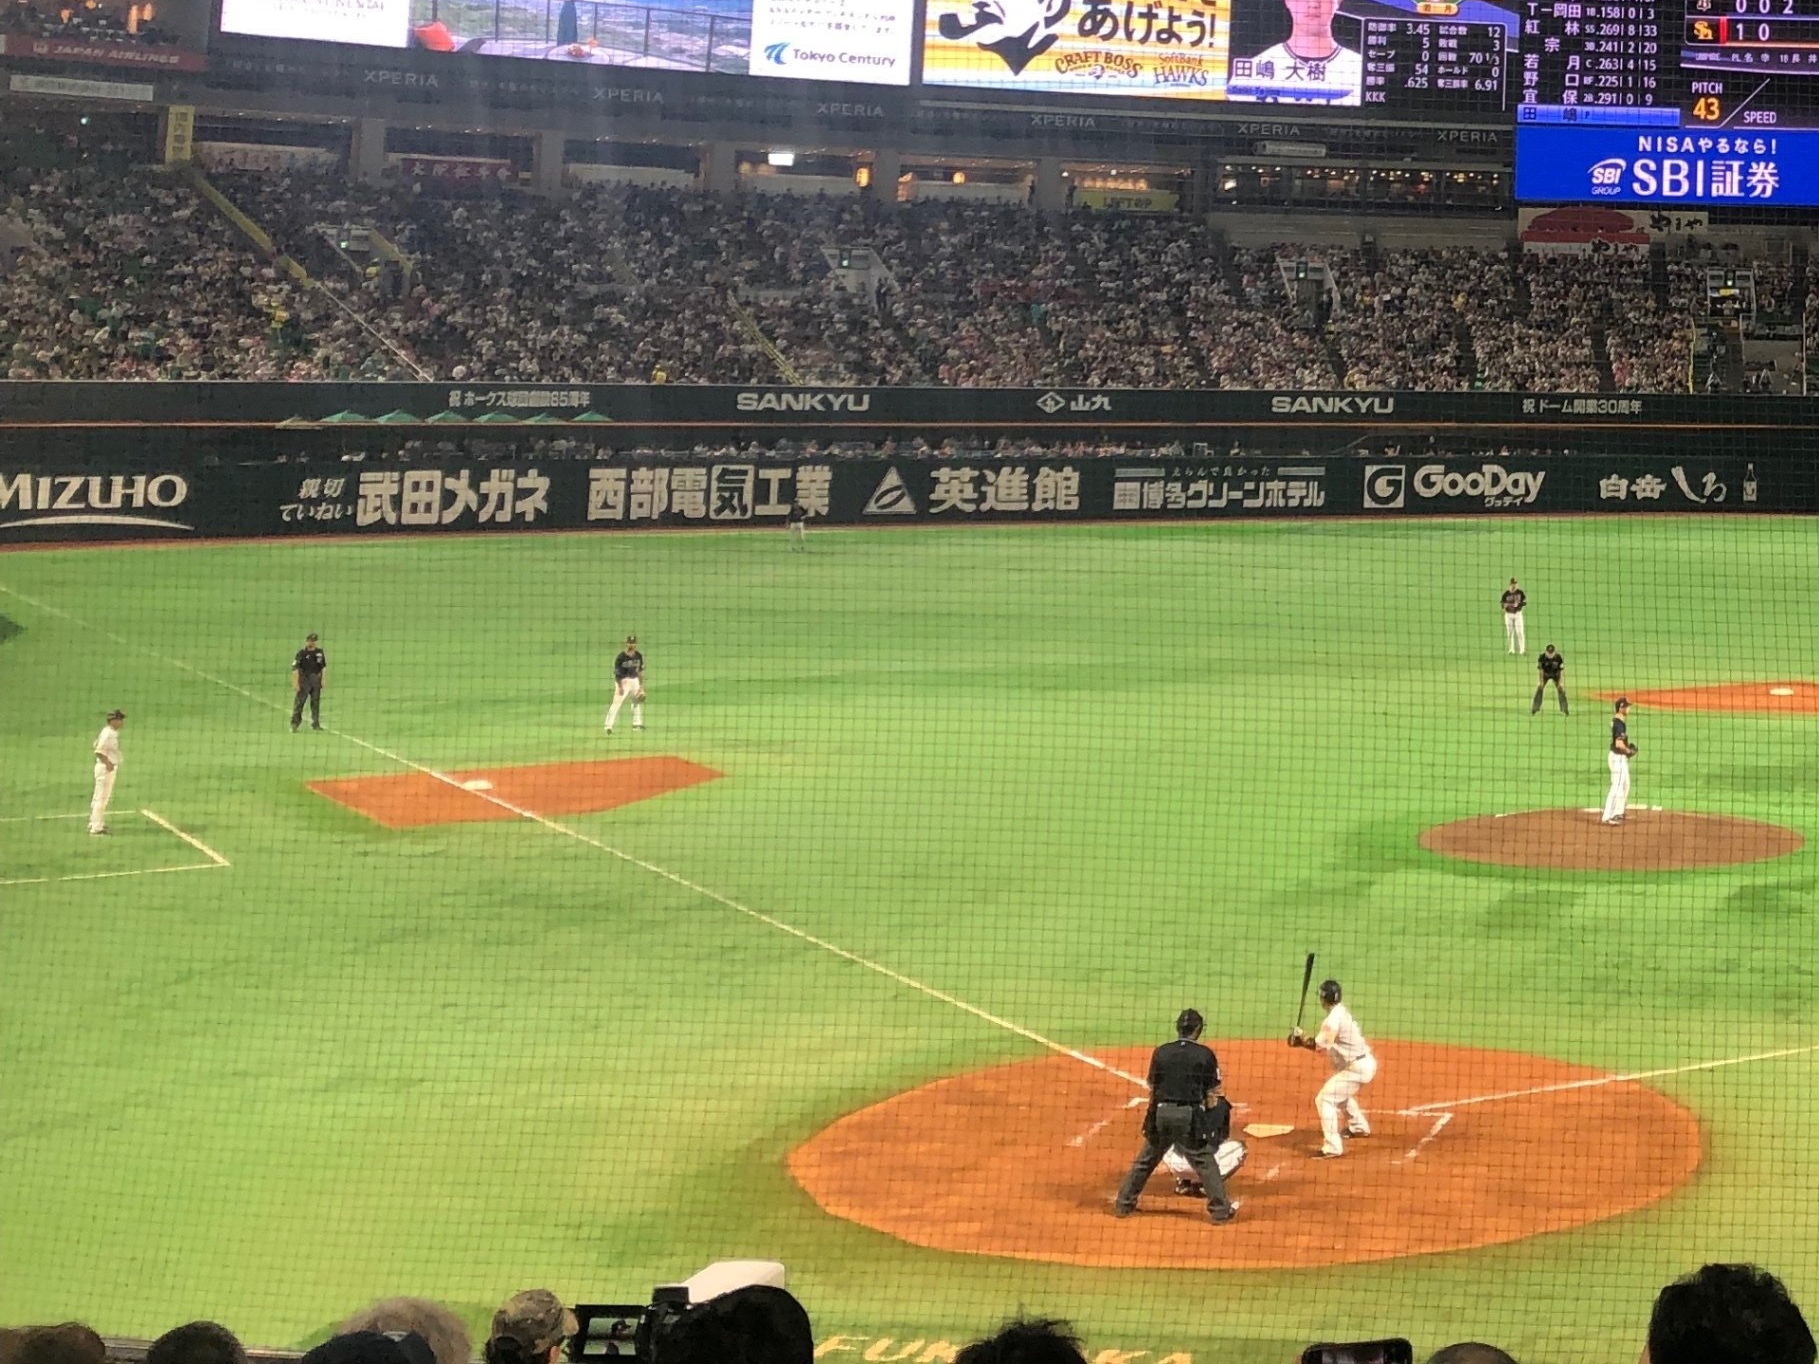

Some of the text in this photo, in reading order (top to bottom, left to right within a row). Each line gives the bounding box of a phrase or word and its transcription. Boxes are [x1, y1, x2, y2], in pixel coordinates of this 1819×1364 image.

[1596, 7, 1620, 19] .158
[1406, 23, 1500, 38] 3.45 12
[1596, 24, 1620, 36] .269
[1758, 23, 1770, 41] 0
[54, 45, 104, 58] JAPAN
[1545, 38, 1618, 53] 宗 .241
[793, 48, 896, 67] Tokyo Century
[1368, 50, 1396, 59] セーブ
[1055, 51, 1144, 78] CRAFT BOSS
[1235, 60, 1326, 81] 田嶋 大樹
[1415, 64, 1428, 75] 54
[1595, 59, 1619, 70] .263
[1153, 65, 1209, 86] HAWKS
[1595, 76, 1619, 87] .225
[1474, 80, 1498, 91] 6.91
[1691, 82, 1723, 94] PITCH
[1366, 91, 1386, 102] KKK
[1595, 93, 1617, 105] .291
[818, 101, 885, 117] XPERIA
[1692, 97, 1720, 120] 43
[1031, 114, 1096, 129] XPERIA
[1743, 111, 1777, 124] SPEED
[1237, 123, 1300, 137] XPERIA
[1437, 130, 1498, 143] XPERIA
[1638, 136, 1776, 155] NISAやるなら!
[1591, 168, 1622, 184] SBI
[1632, 158, 1779, 198] SBI証券
[1591, 187, 1621, 195] GROUP
[736, 392, 871, 412] SANKYU
[1070, 394, 1112, 412] 山九
[1271, 397, 1395, 414] SANKYU
[0, 473, 188, 511] MIZUHO
[928, 465, 1081, 513] 英進館
[1413, 465, 1546, 503] GooDay
[1599, 473, 1667, 501] 白岳
[356, 468, 552, 527] 武田メガネ
[587, 464, 834, 521] 西部電気工業
[1142, 479, 1325, 510] 博多グリーンホテル
[278, 501, 354, 522] ていねい
